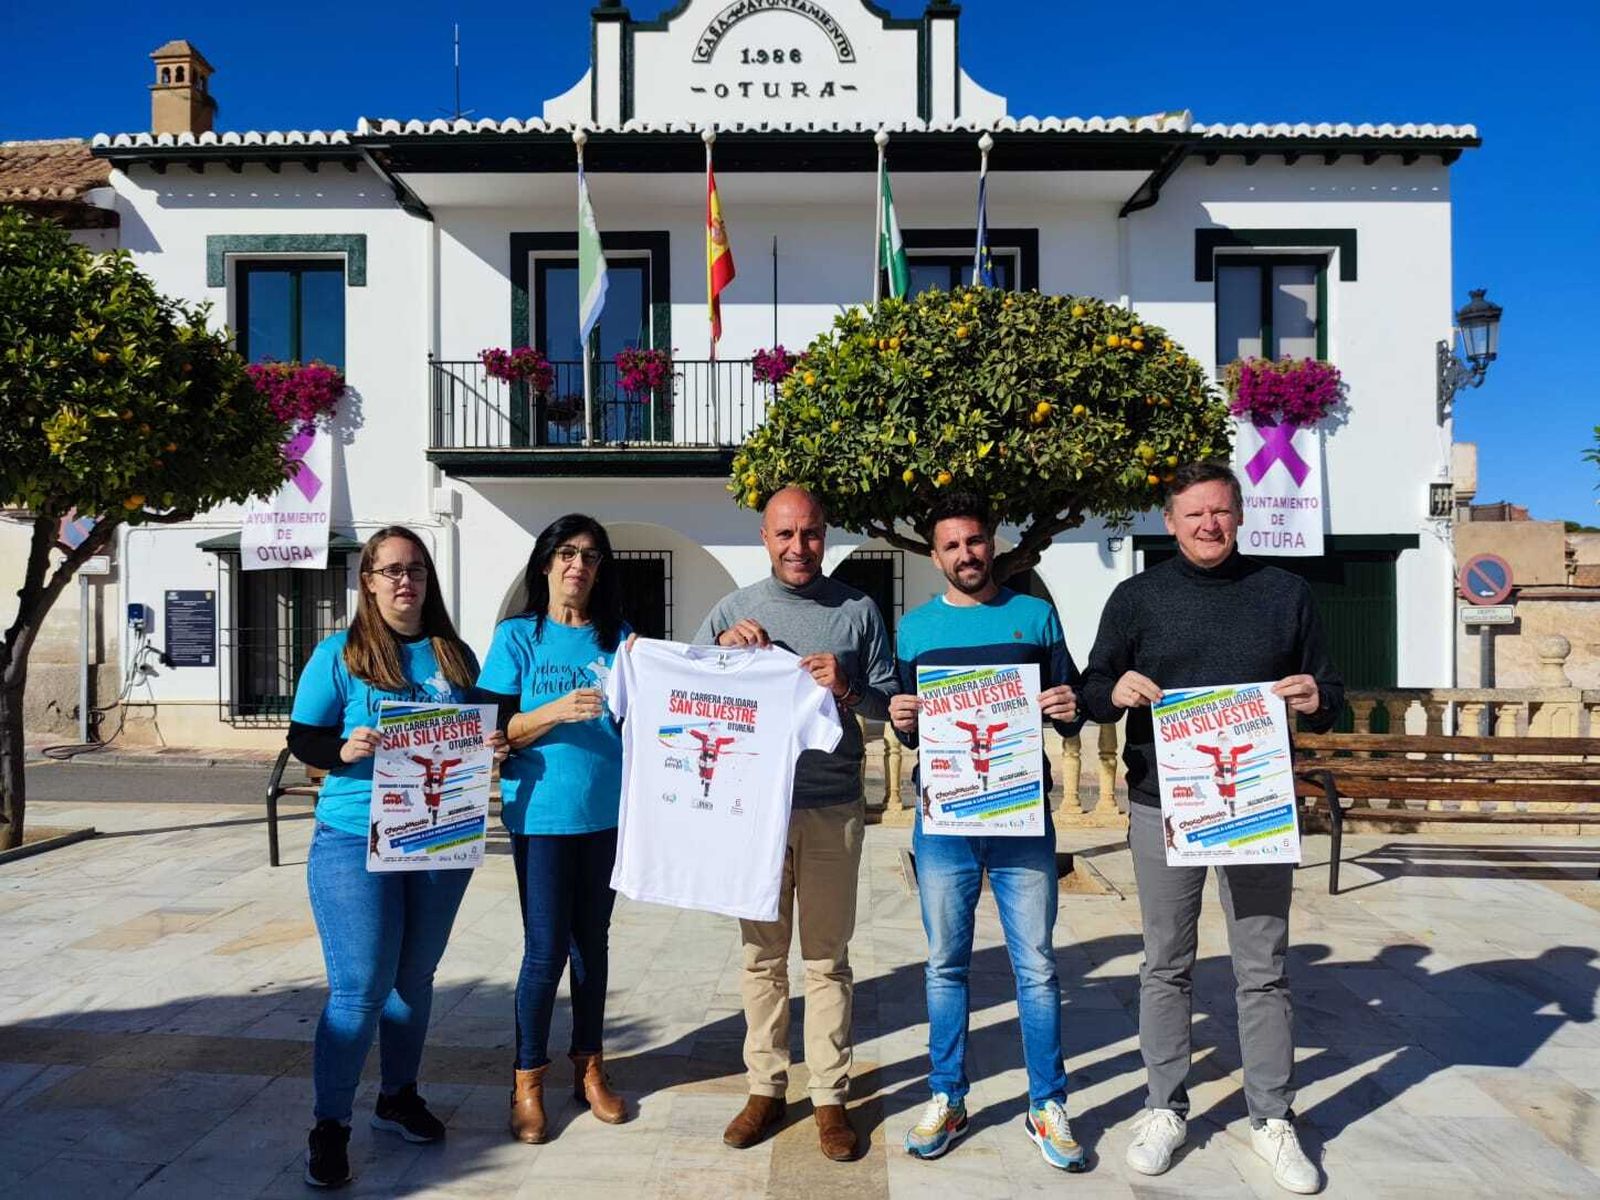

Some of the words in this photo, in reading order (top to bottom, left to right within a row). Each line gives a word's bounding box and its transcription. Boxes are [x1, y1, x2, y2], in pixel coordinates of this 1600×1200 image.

[697, 17, 729, 57] CASA
[740, 48, 802, 64] 1.986
[1243, 496, 1319, 509] YUNTAMIENTO
[246, 512, 327, 524] AYUNTAMIENTO
[1271, 514, 1285, 526] DE
[277, 528, 292, 540] DE
[1250, 531, 1306, 549] OTURA
[257, 546, 314, 562] OTURA
[922, 687, 942, 700] XXVI
[942, 680, 979, 696] CARRERA
[979, 670, 1021, 688] SOLIDARIA
[671, 688, 688, 700] XXVI
[690, 691, 722, 704] CARRERA
[722, 695, 758, 709] SOLIDARIA
[923, 696, 952, 717] SAN
[953, 680, 1026, 710] SILVESTRE
[1159, 713, 1179, 726] XXVI
[1179, 704, 1218, 720] CARRERA
[1219, 689, 1263, 709] SOLIDARIA
[669, 698, 693, 715] SAN
[695, 701, 756, 724] SILVESTRE
[1160, 721, 1191, 742] SAN
[1192, 698, 1269, 734] SILVESTRE
[383, 725, 402, 736] XXVI
[404, 718, 440, 732] CARRERA
[441, 711, 481, 726] SOLIDARIA
[382, 732, 410, 751] SAN
[413, 721, 482, 746] SILVESTRE
